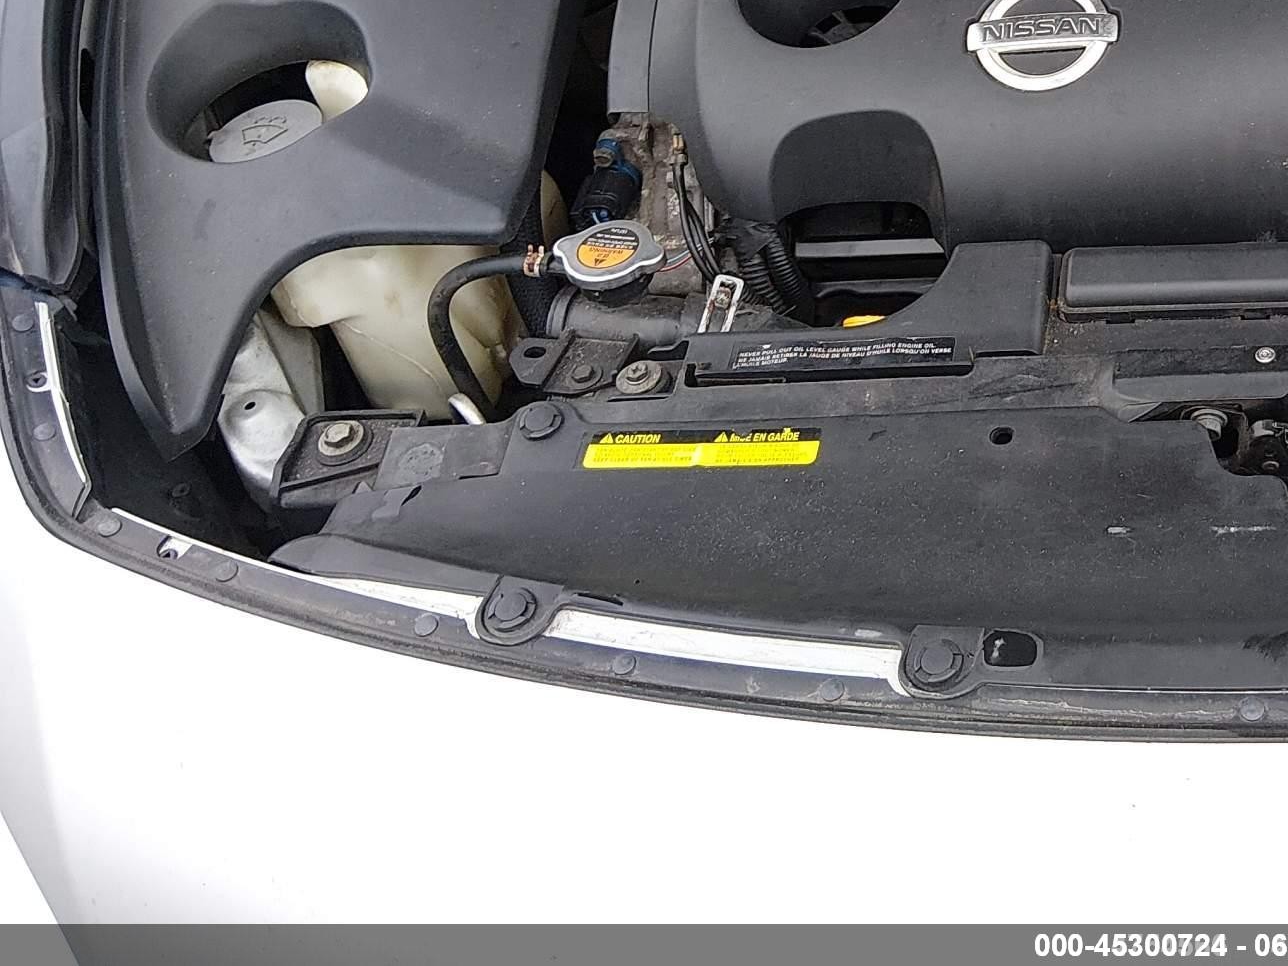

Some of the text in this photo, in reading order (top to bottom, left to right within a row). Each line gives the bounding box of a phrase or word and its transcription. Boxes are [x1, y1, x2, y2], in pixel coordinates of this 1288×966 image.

[983, 16, 1101, 40] NISSAN
[615, 434, 661, 443] CAUTION
[753, 433, 766, 441] EN
[767, 432, 800, 441] GARDE
